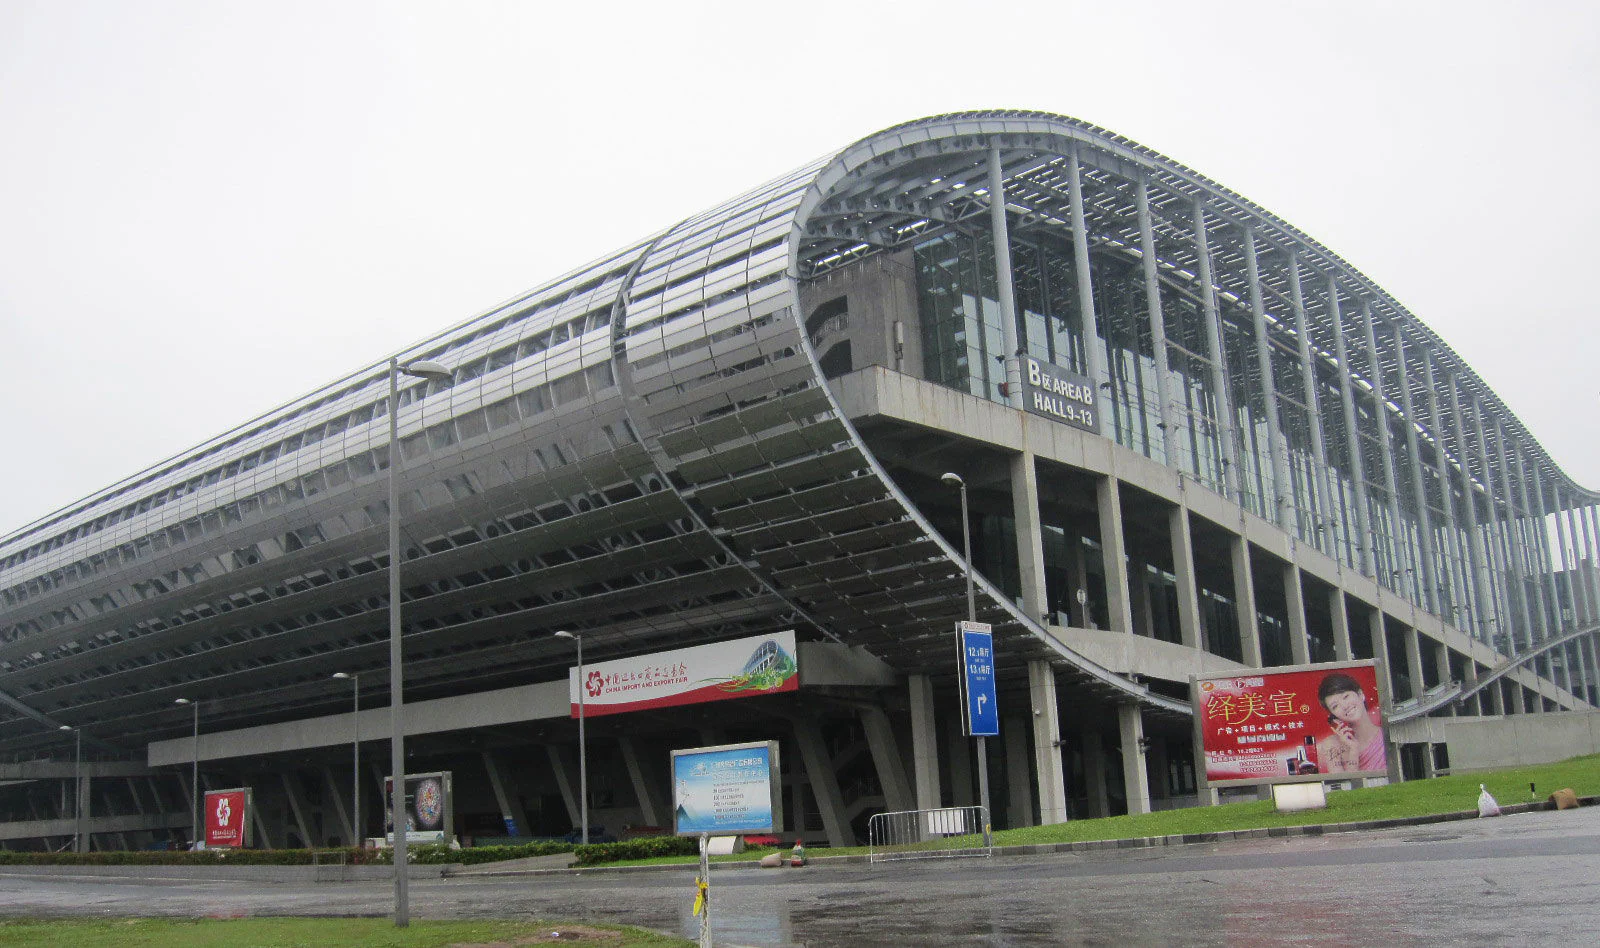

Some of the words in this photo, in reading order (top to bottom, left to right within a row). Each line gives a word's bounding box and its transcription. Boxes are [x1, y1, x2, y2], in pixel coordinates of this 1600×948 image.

[1053, 378, 1083, 402] AREA
[1083, 385, 1093, 405] B
[1033, 392, 1067, 418] HALL
[1066, 405, 1093, 426] 9-13
[605, 685, 621, 693] CHINA
[622, 683, 641, 692] IMPORT
[653, 678, 674, 687] EXPORT
[675, 676, 688, 684] FAIR
